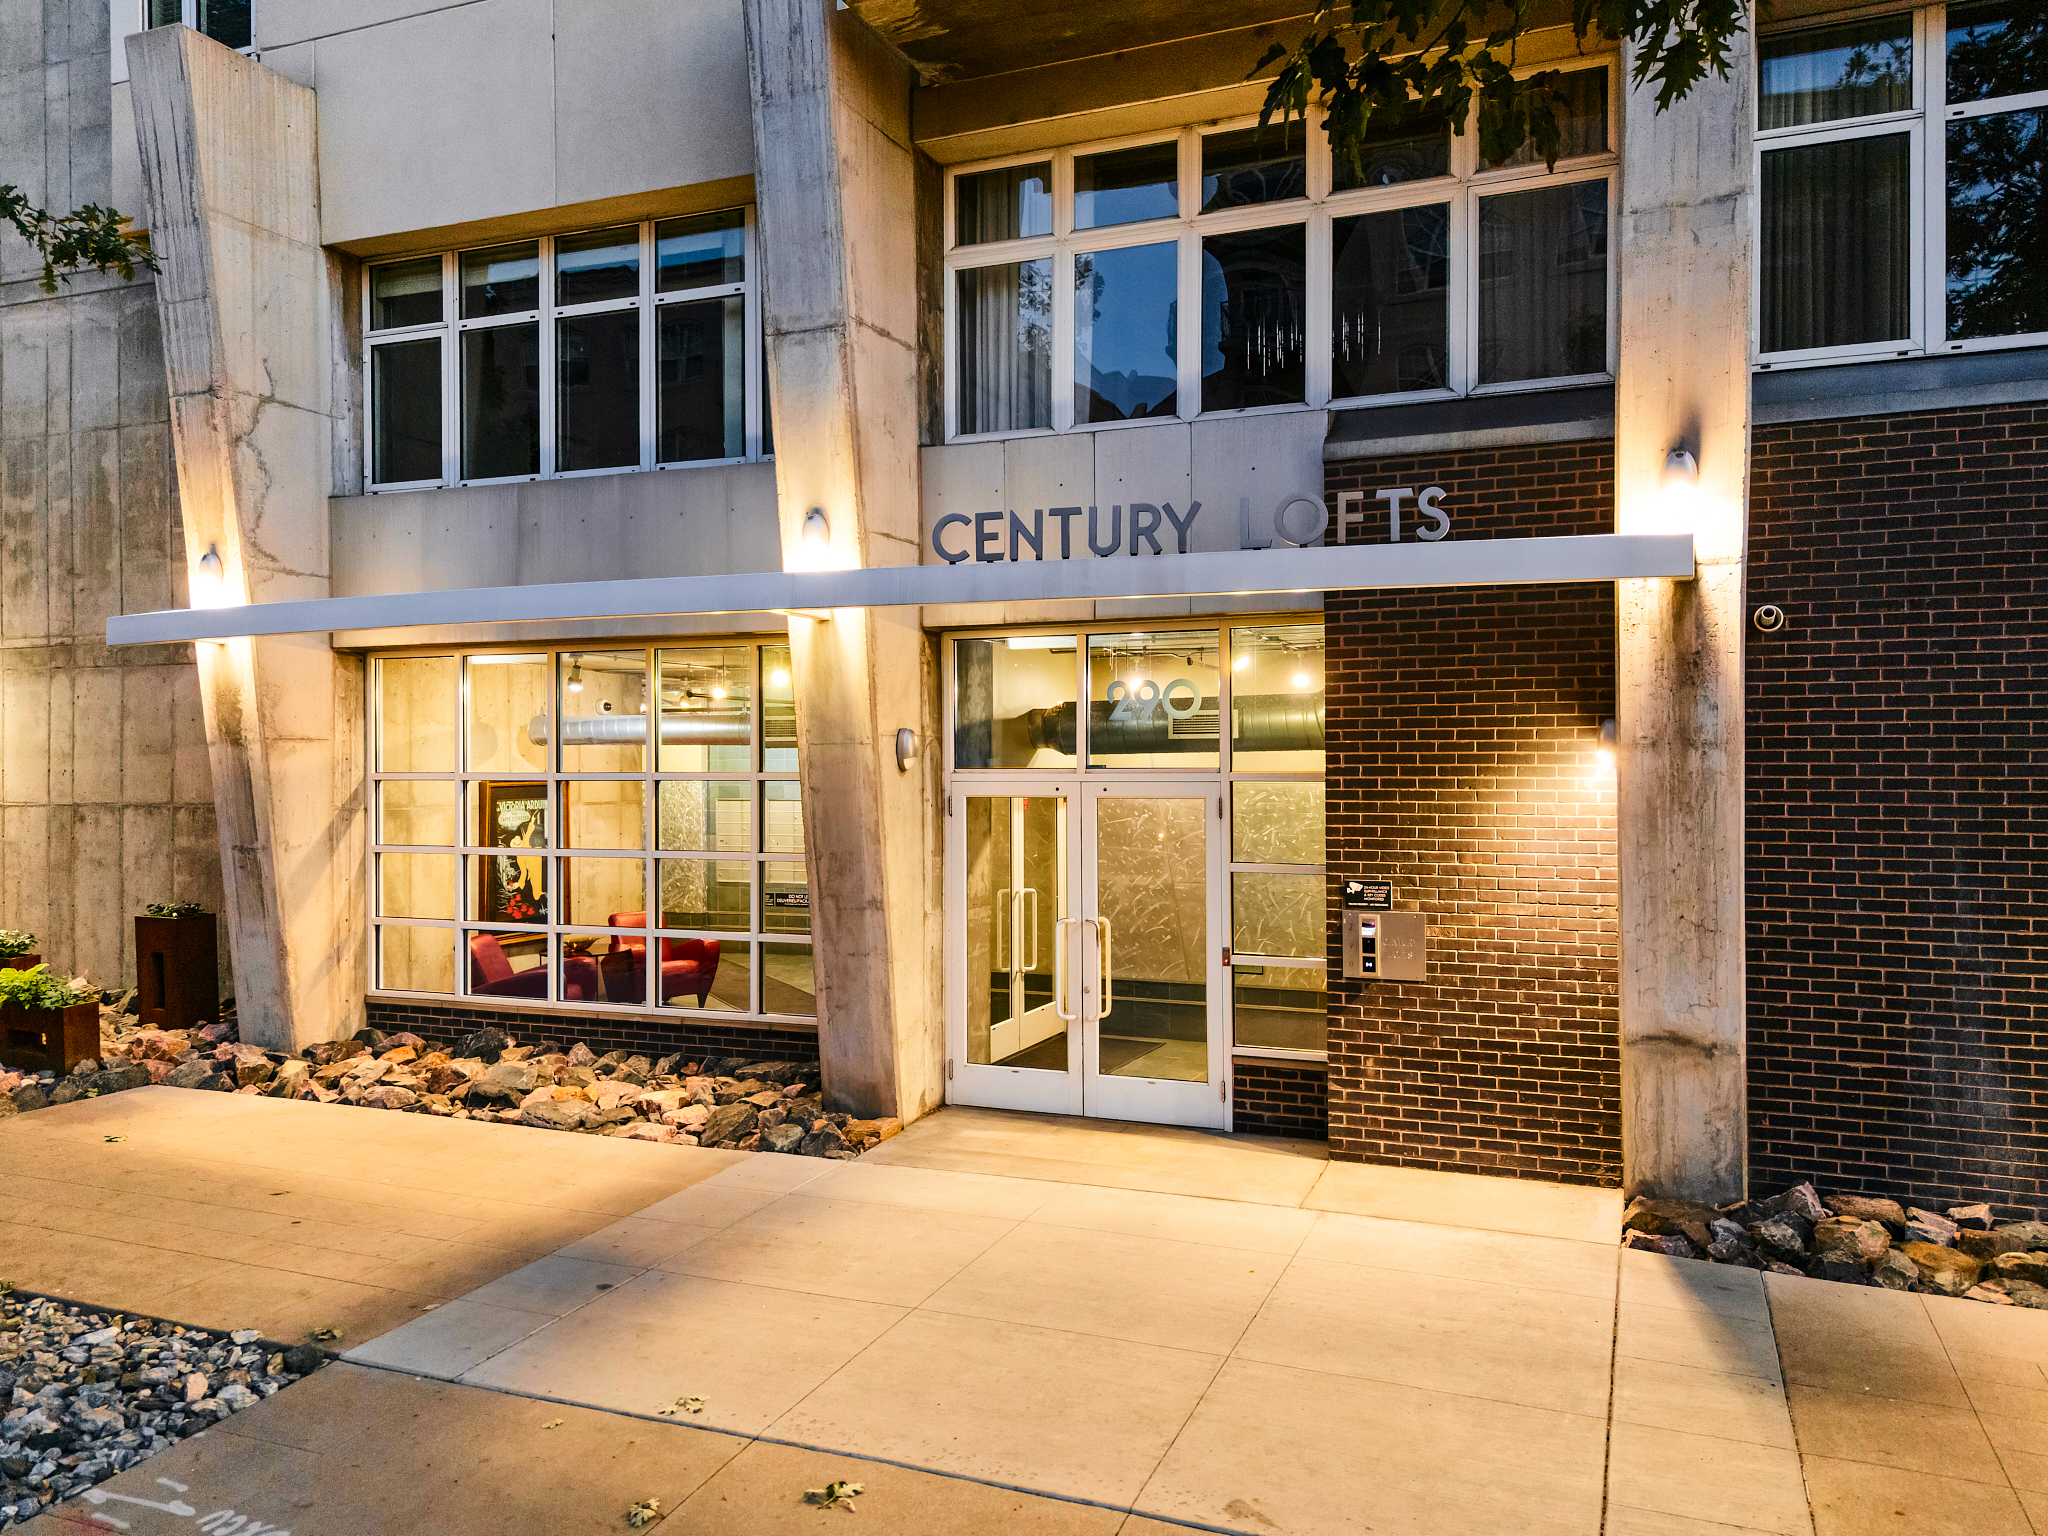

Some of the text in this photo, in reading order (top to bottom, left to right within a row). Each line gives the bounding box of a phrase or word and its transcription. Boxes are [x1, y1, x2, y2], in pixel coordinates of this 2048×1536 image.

[931, 486, 1451, 563] CENTURY LOFTS
[1107, 678, 1202, 722] 290
[499, 801, 526, 811] VICTORIA
